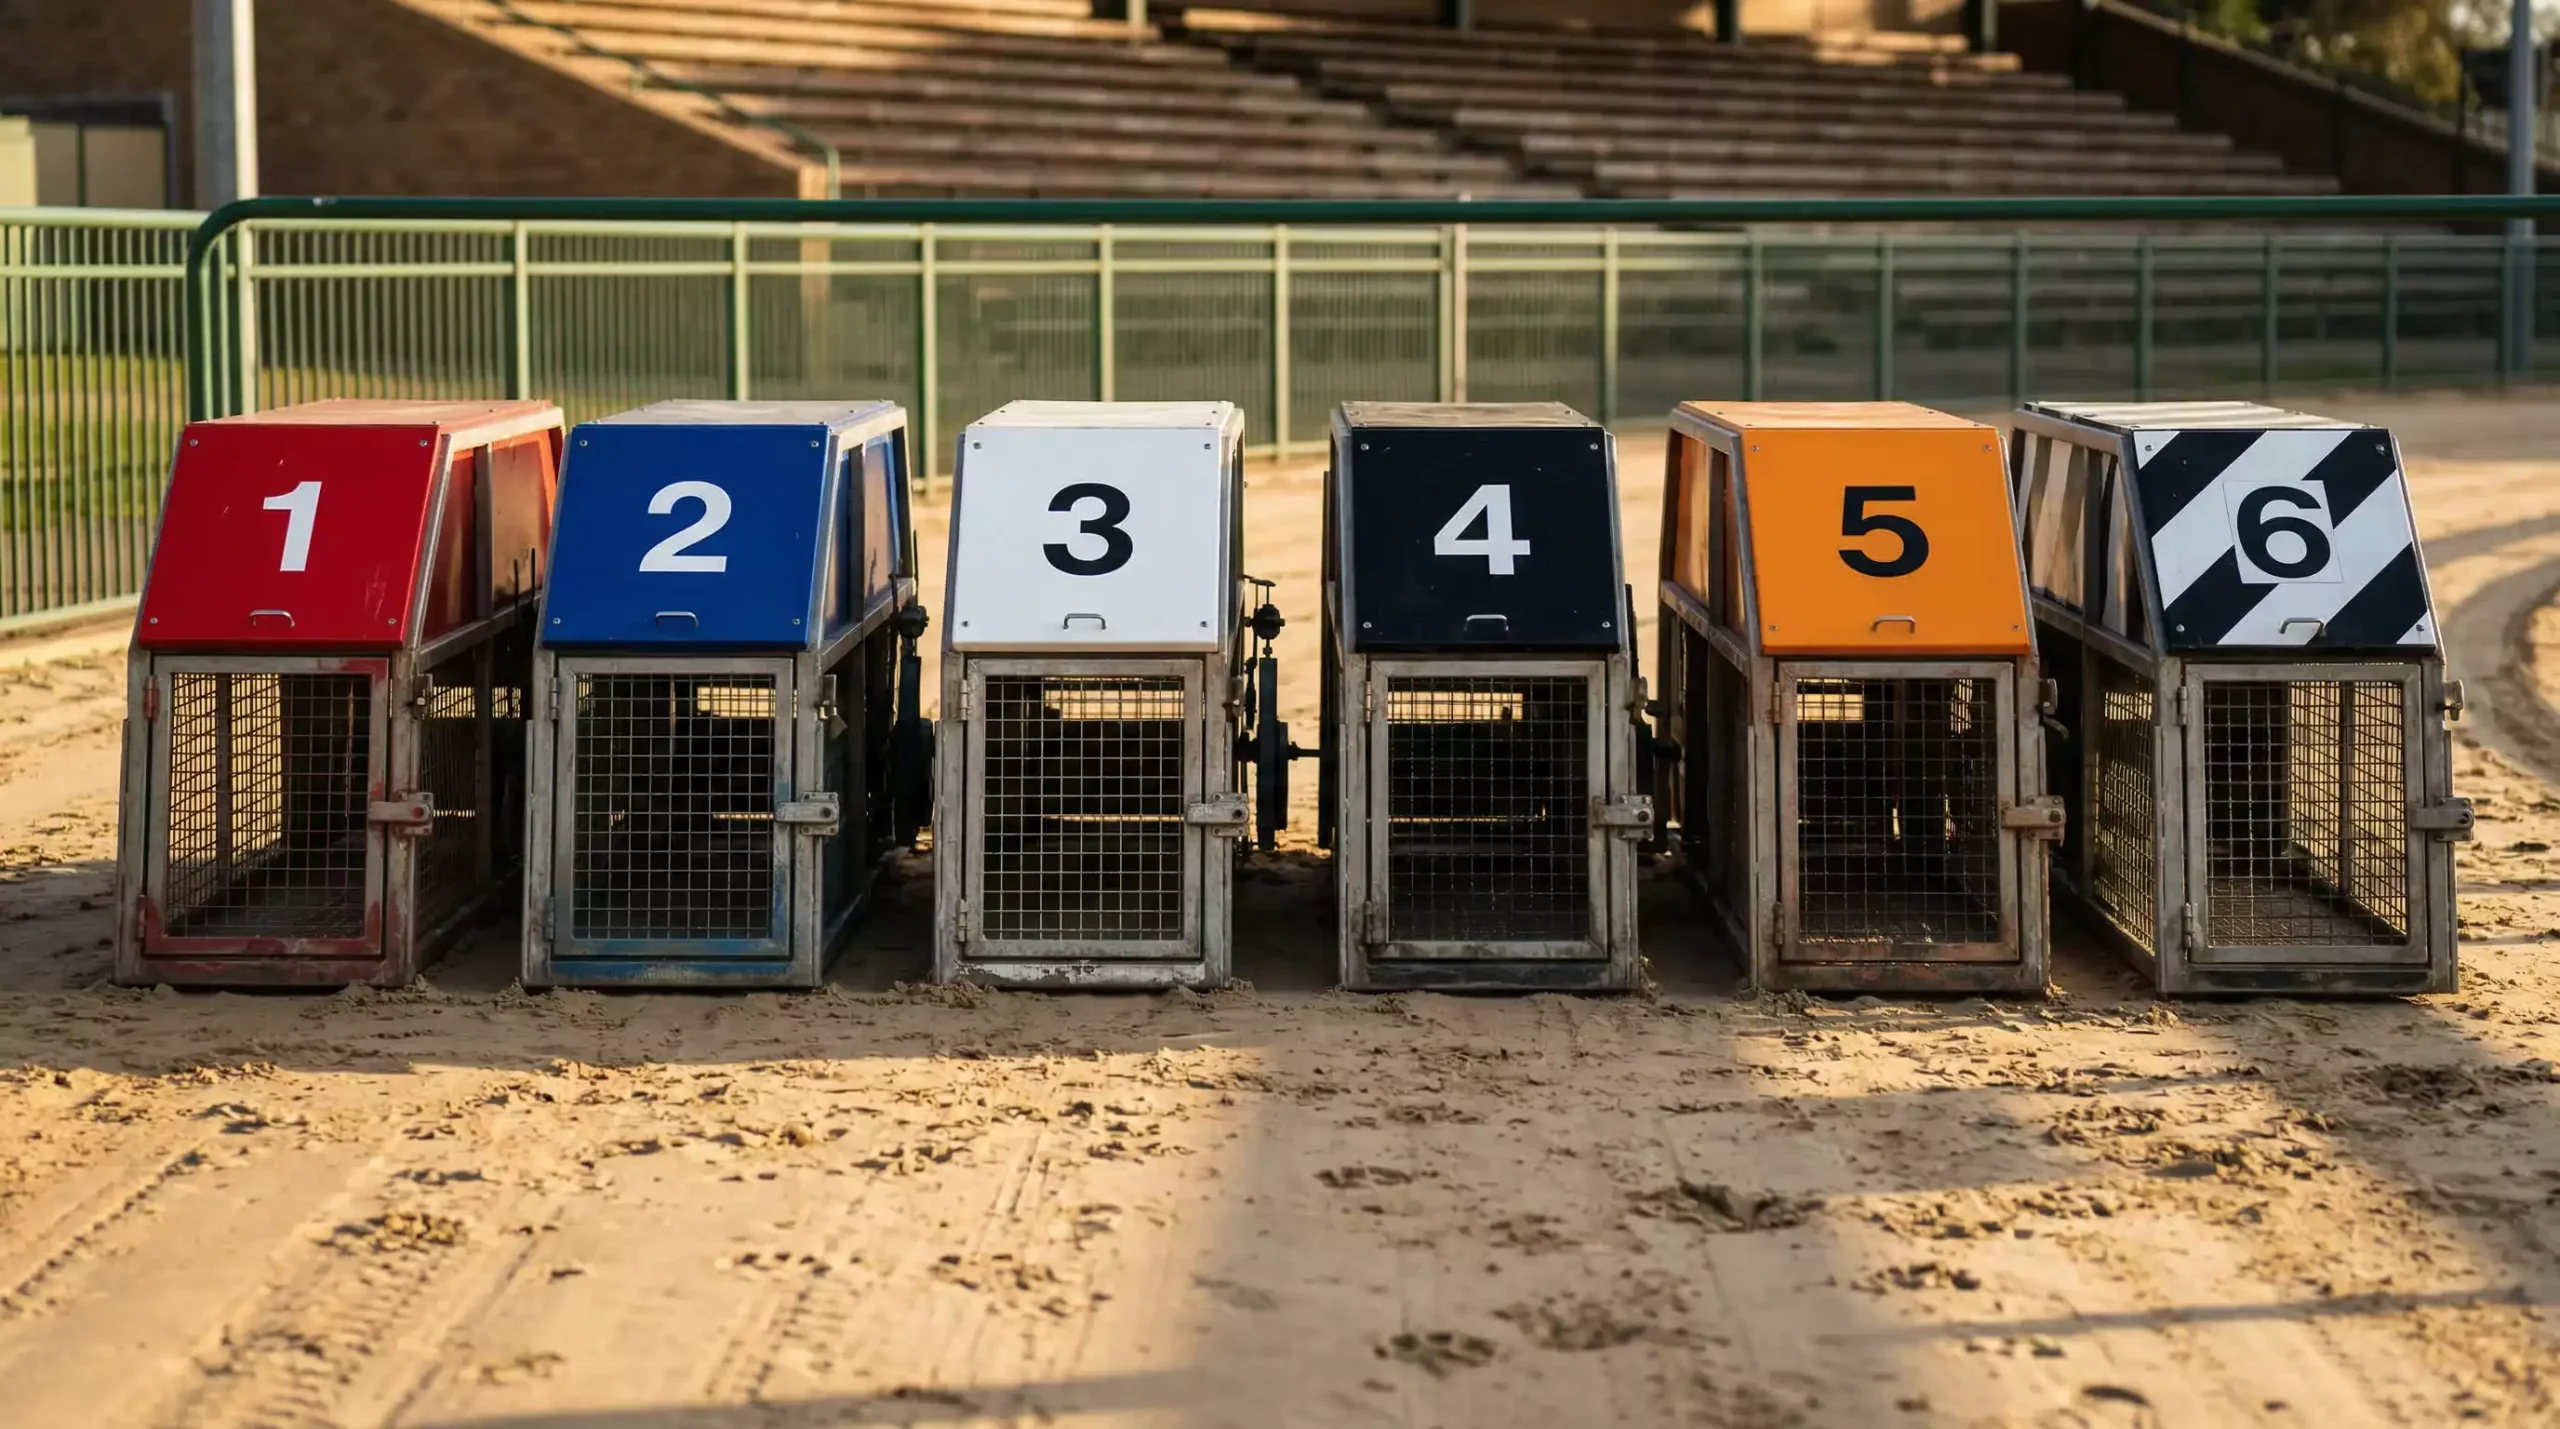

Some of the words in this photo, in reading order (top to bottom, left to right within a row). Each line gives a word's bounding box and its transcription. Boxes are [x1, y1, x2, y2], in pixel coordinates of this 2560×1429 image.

[263, 482, 321, 572] 1
[639, 481, 731, 573] 2
[1043, 483, 1133, 576] 3
[1434, 485, 1530, 575] 4
[1839, 486, 1930, 578] 5
[2237, 486, 2331, 579] 6
